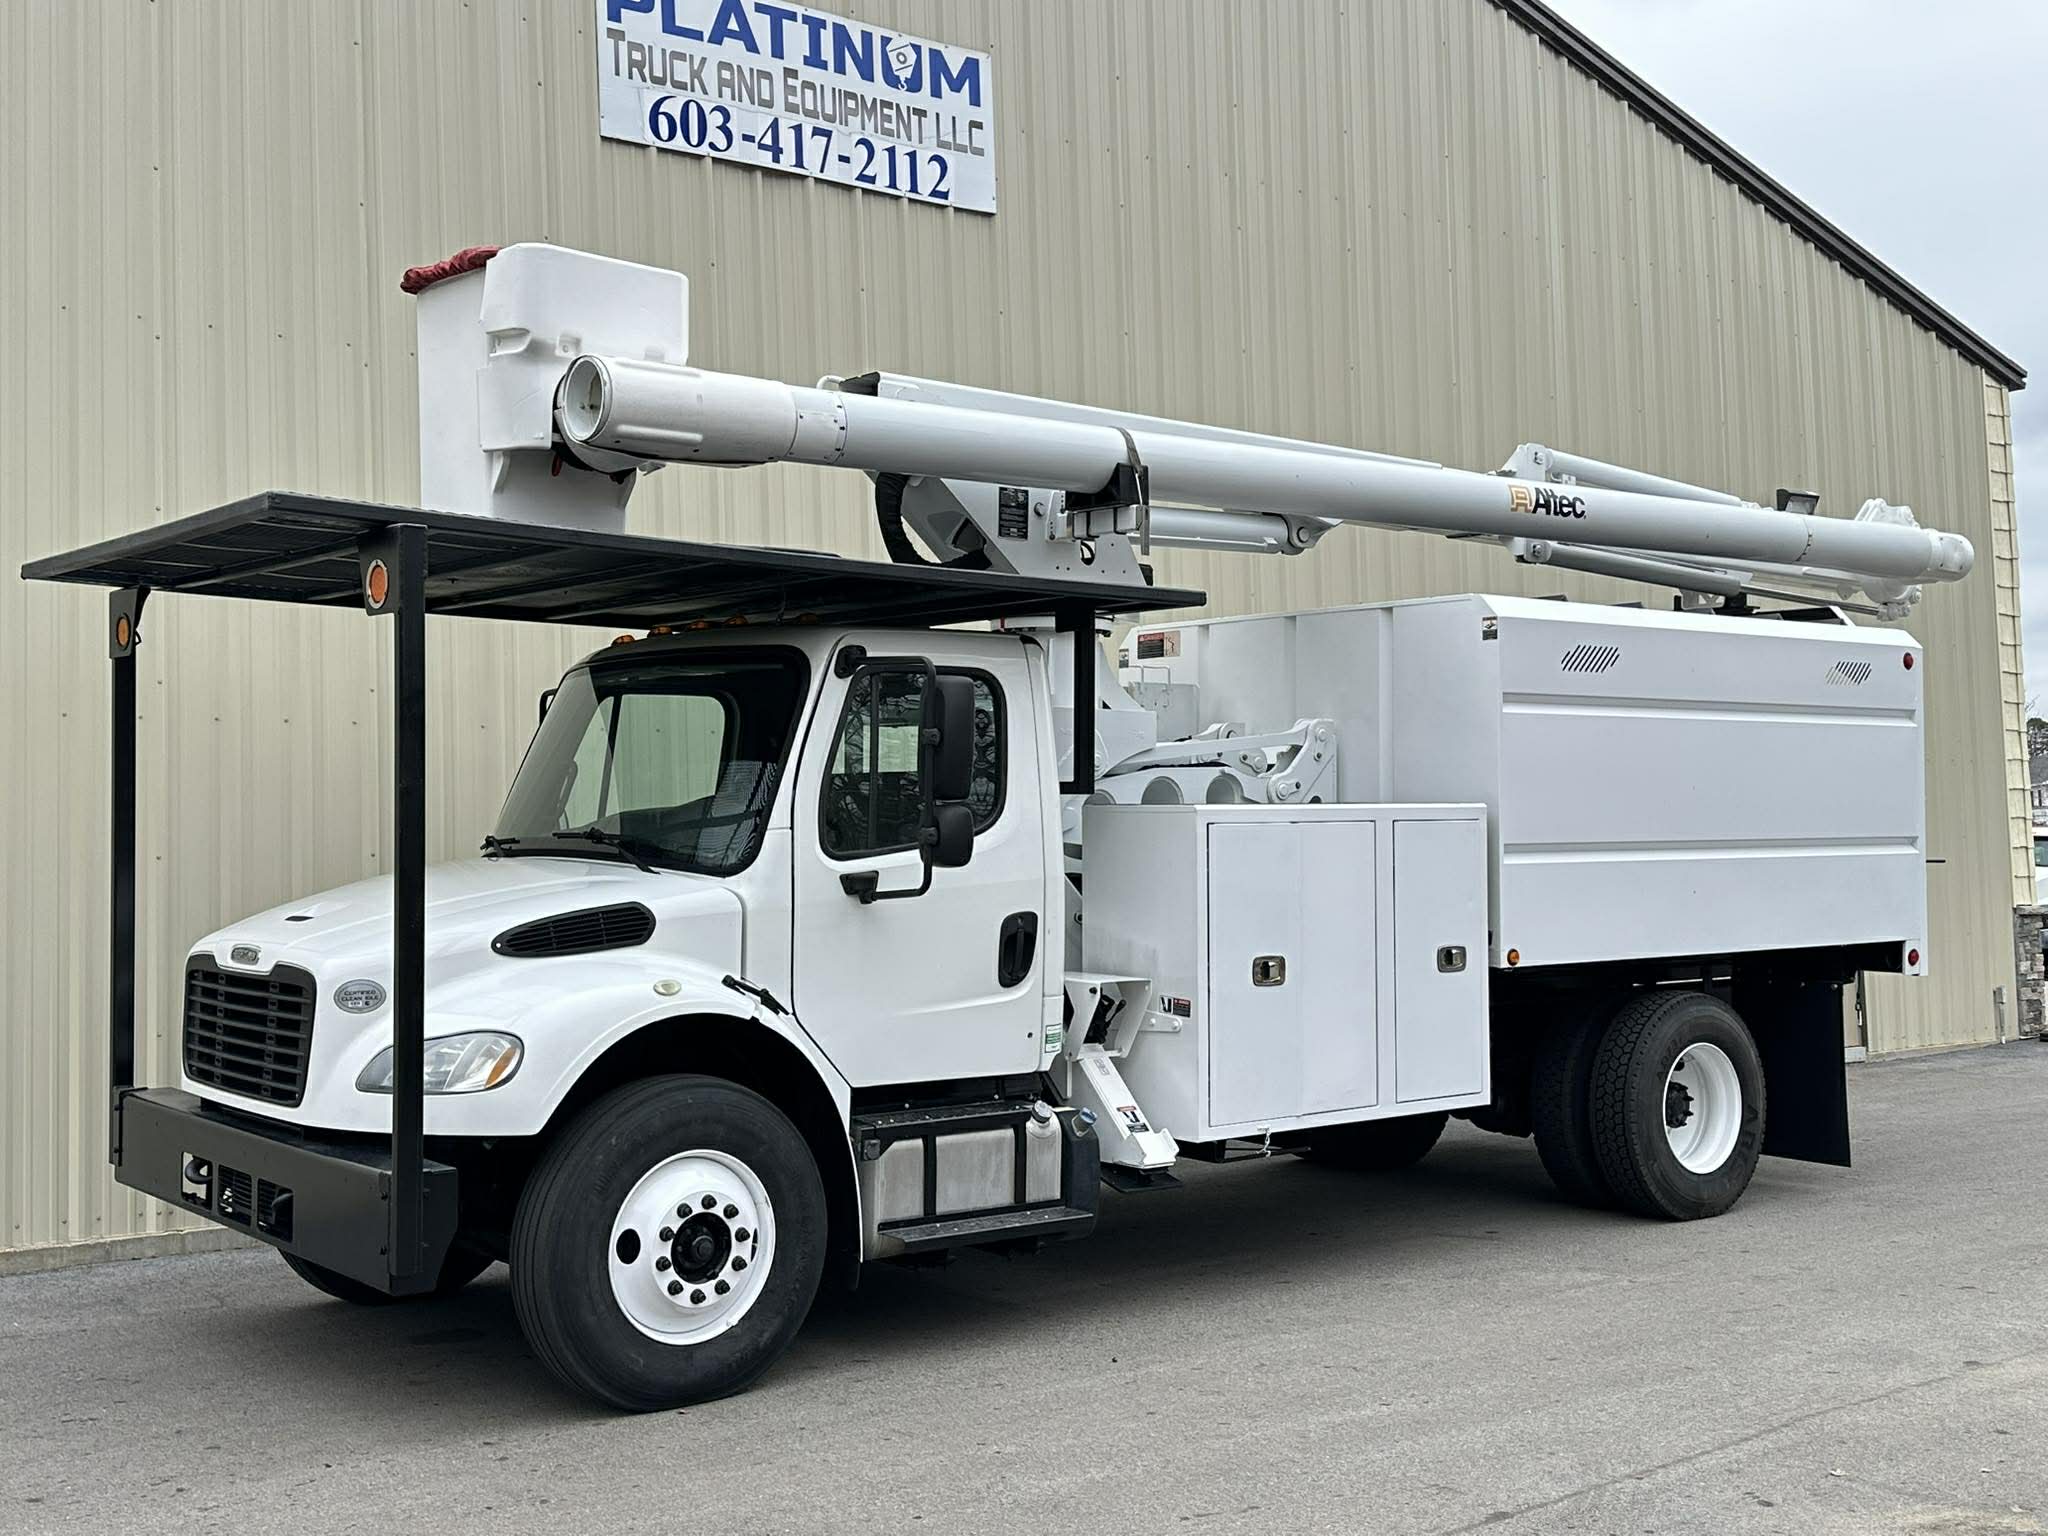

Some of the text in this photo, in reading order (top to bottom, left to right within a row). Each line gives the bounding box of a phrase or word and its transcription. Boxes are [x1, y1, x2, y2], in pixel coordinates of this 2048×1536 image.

[607, 27, 984, 157] TRUCK AND EQUIPMENT LLC
[649, 95, 950, 200] 603-417-2112
[1532, 487, 1585, 518] Altec
